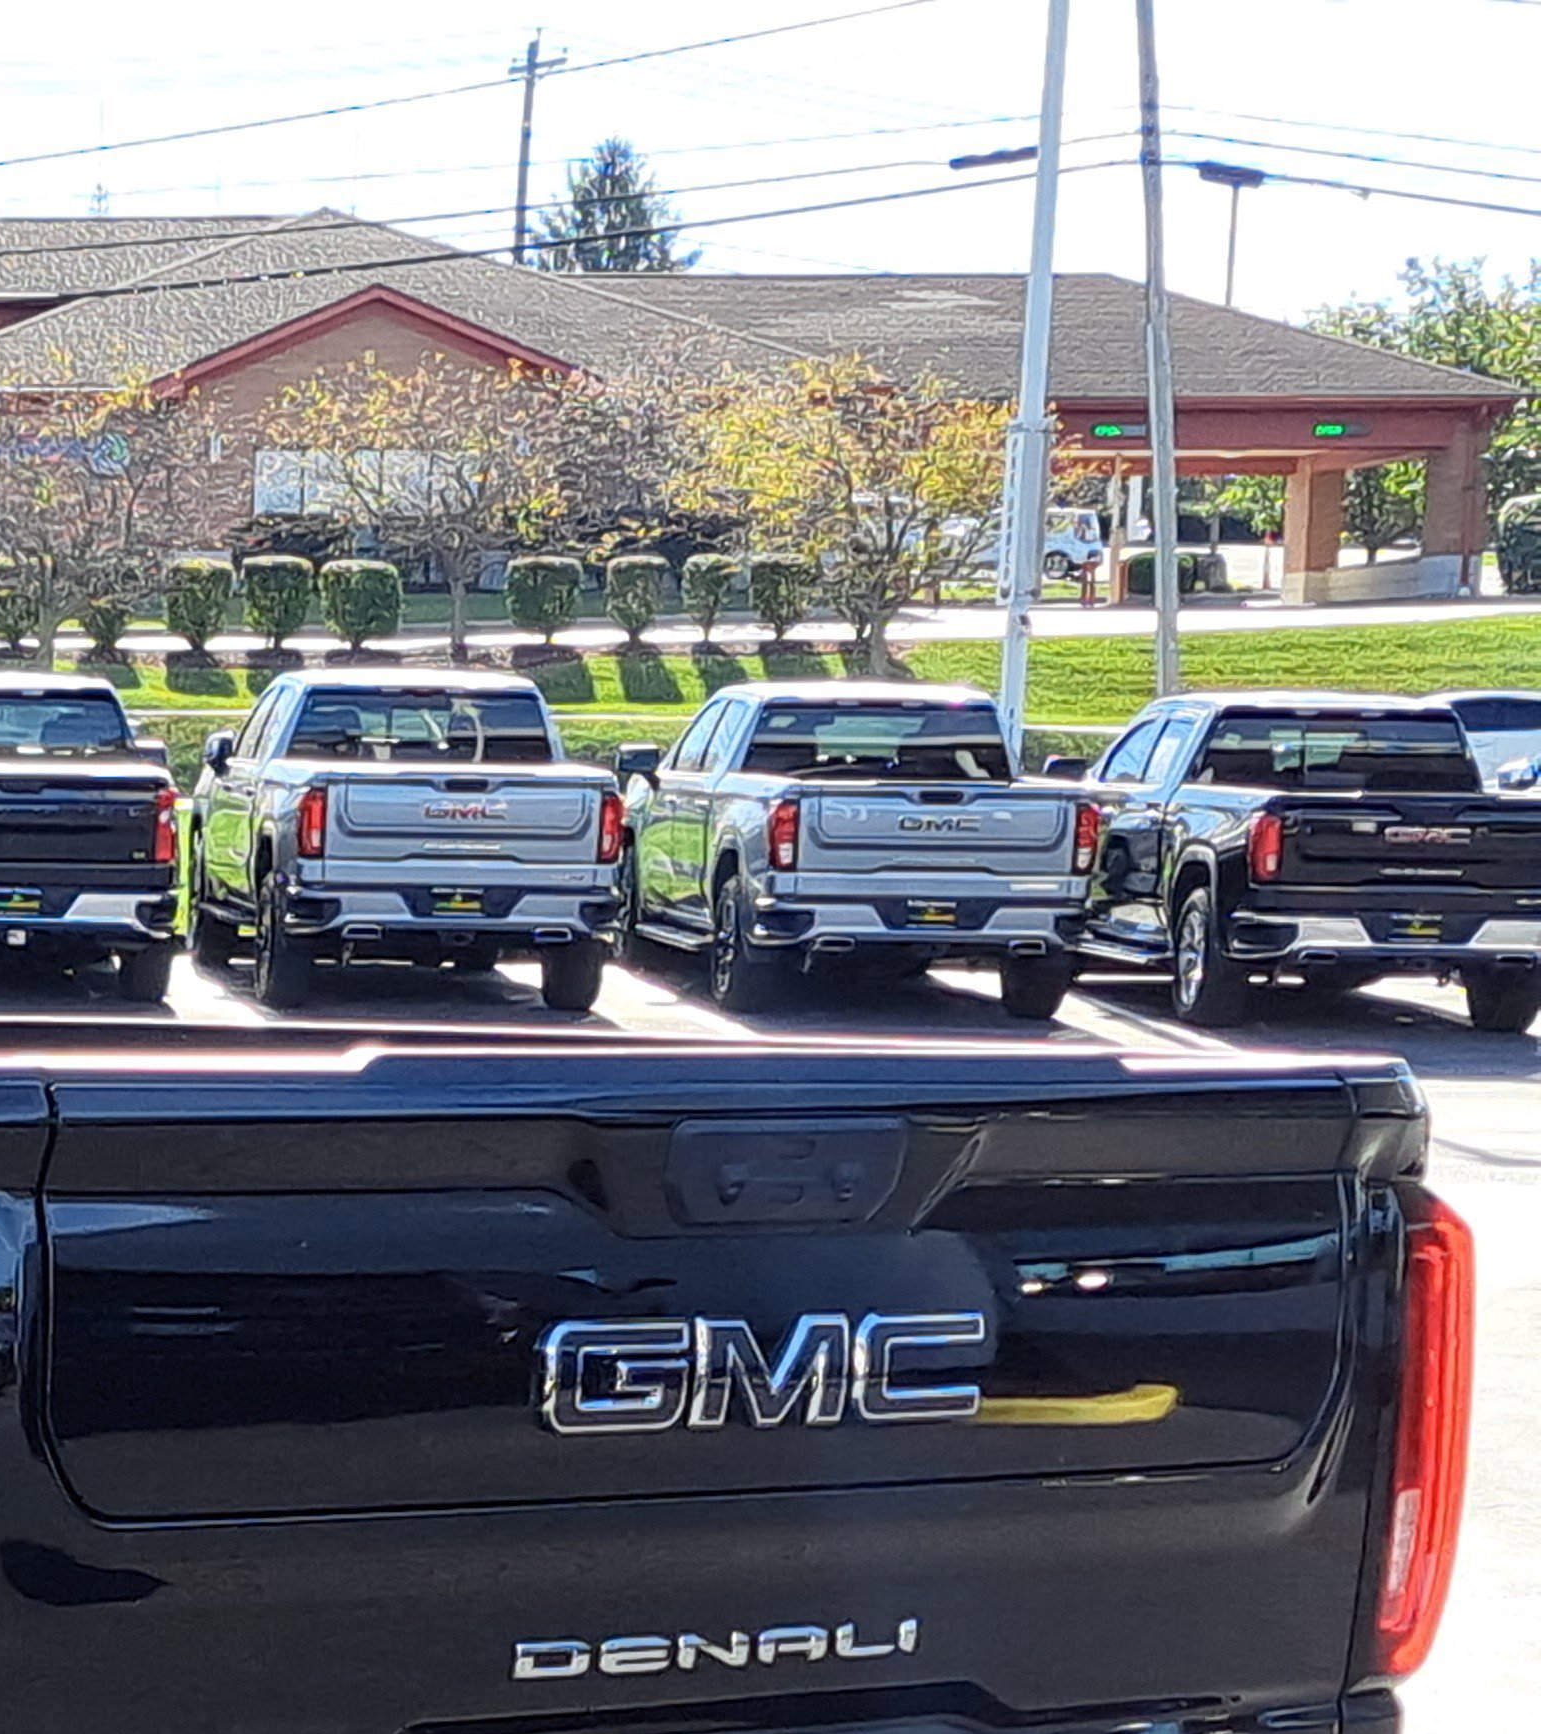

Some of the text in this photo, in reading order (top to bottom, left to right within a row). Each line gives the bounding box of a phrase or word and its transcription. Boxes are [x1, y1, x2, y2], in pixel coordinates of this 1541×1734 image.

[898, 815, 982, 832] GMC
[540, 1309, 986, 1435] GMC
[511, 1617, 918, 1681] DENALI
